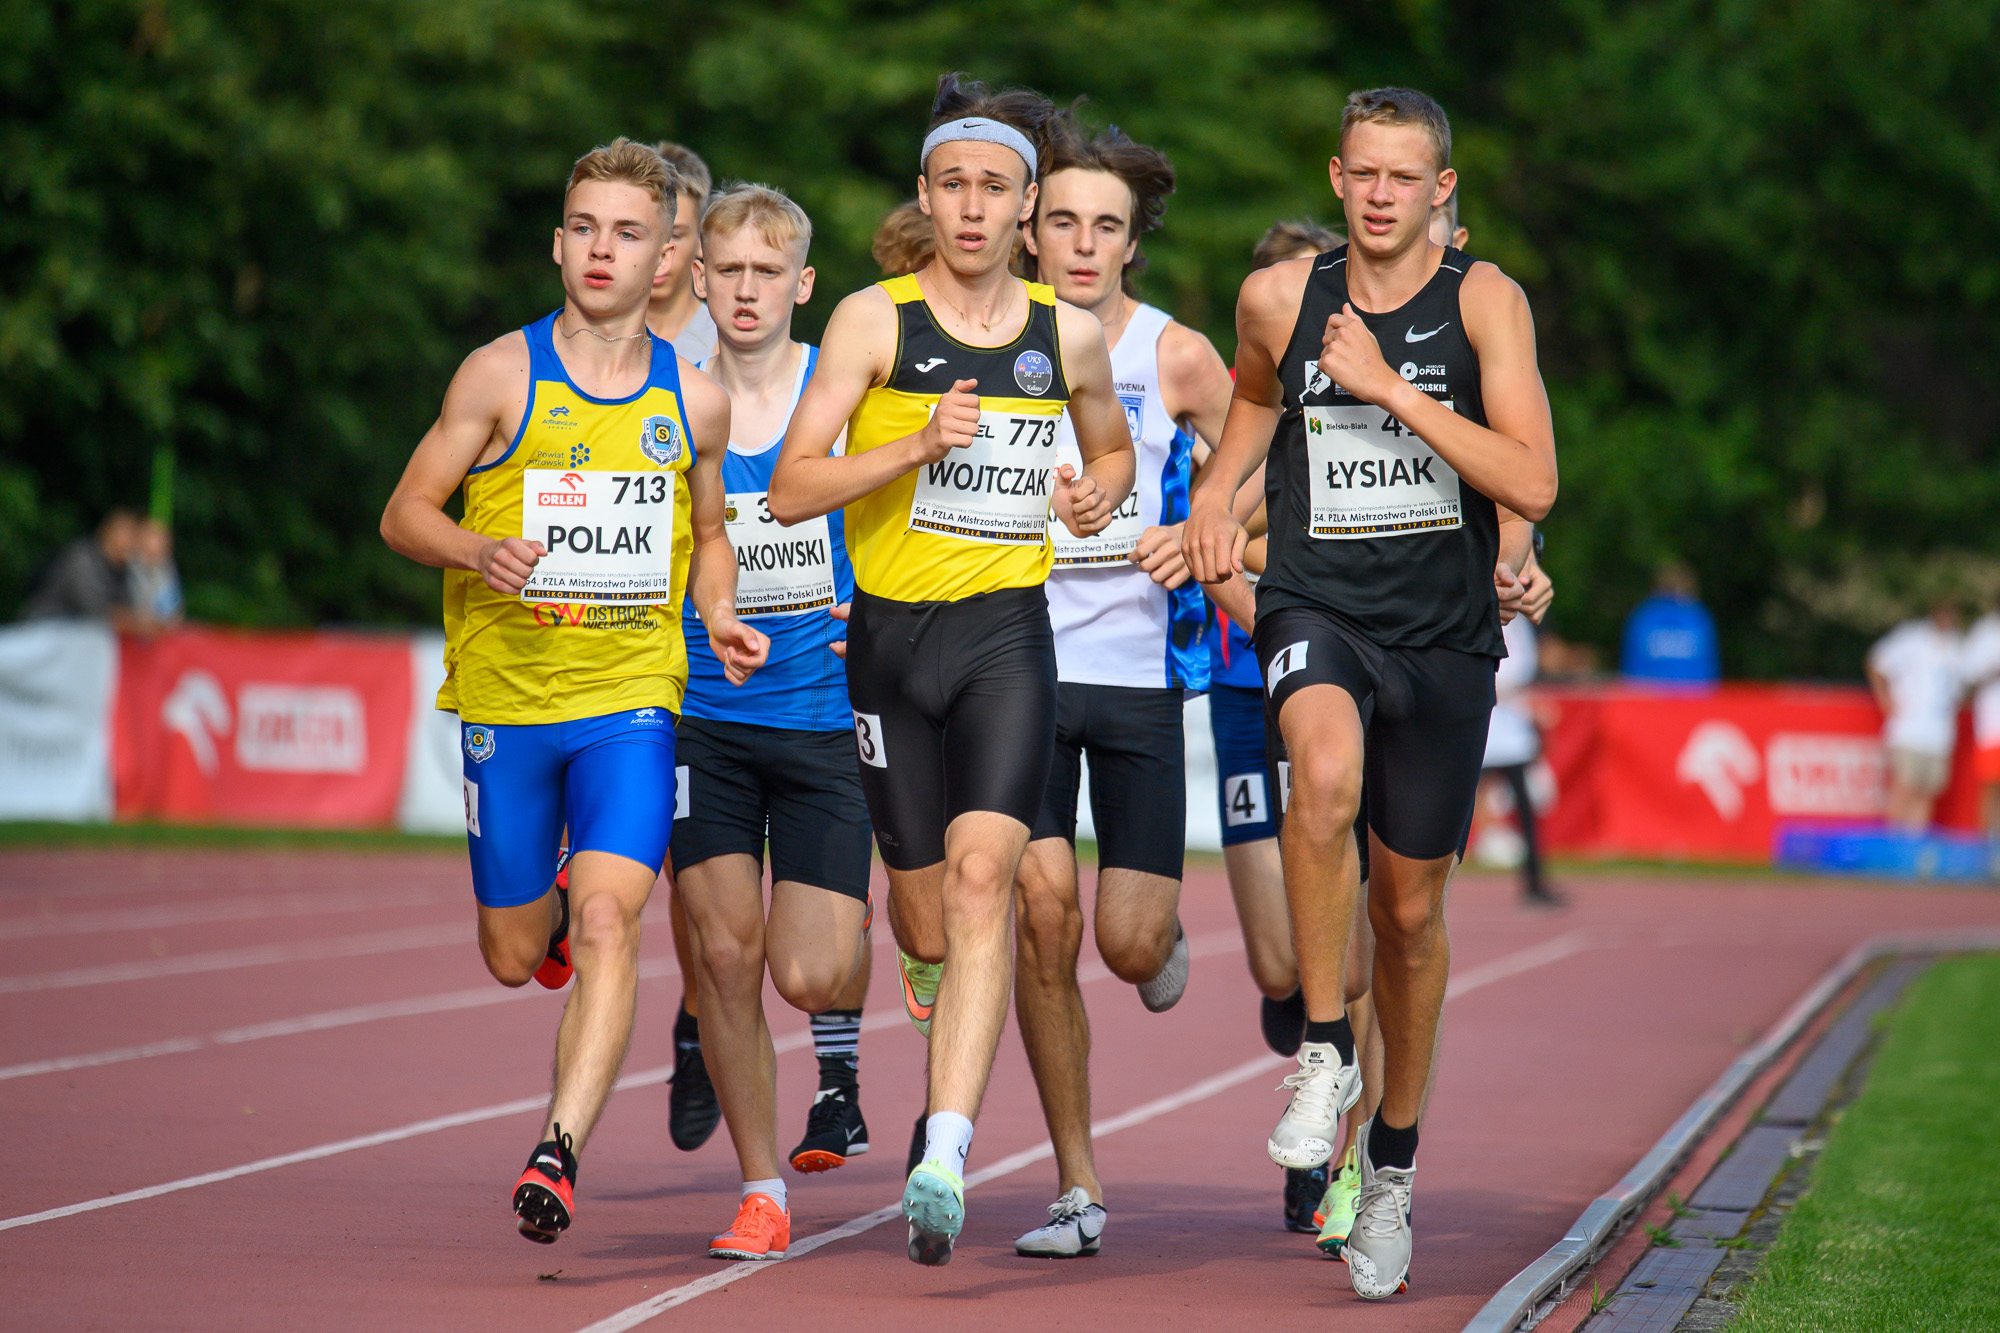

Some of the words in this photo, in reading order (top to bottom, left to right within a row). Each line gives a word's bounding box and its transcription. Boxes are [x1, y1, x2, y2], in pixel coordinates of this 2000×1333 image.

[1419, 368, 1446, 376] OPOLE
[1114, 382, 1146, 392] UVENIA
[1412, 383, 1447, 392] POLSKIE
[659, 429, 667, 440] S
[1009, 419, 1055, 447] 773
[1327, 423, 1368, 431] Bielsko-Biała
[537, 451, 564, 459] Powiat
[525, 459, 565, 467] ostrowski
[928, 460, 1050, 496] WOJTCZAK
[1327, 456, 1436, 489] ŁYSIAK
[612, 476, 666, 504] 713
[540, 494, 584, 505] ORLEN
[914, 506, 929, 517] 54.
[932, 510, 954, 521] PZLA
[957, 515, 1010, 528] Mistrzostwa
[1012, 519, 1033, 529] Polski
[1033, 520, 1045, 529] U18
[1314, 513, 1326, 522] 54.
[1328, 513, 1347, 522] PZLA
[1350, 511, 1406, 522] Mistrzostwa
[1410, 507, 1438, 518] Polski
[1440, 504, 1458, 515] U18
[915, 519, 980, 537] BIELSKO-BIAŁA
[1315, 526, 1377, 534] BIELSKO-BIAŁA
[1393, 518, 1456, 531] 15-17.07.2022
[547, 525, 652, 554] POLAK
[1105, 542, 1128, 551] Polski
[732, 538, 826, 572] AKOWSKI
[543, 577, 565, 586] PZLA
[569, 578, 626, 588] Mistrzostwa
[629, 579, 651, 588] Polski
[654, 578, 667, 587] U18
[527, 590, 595, 600] BIELSKO-BIAŁA
[611, 592, 665, 600] 15-17.07.2022
[787, 589, 814, 600] Polski
[816, 585, 832, 596] U18
[772, 597, 832, 612] 15-17.07.2022
[857, 716, 876, 761] 3
[1232, 779, 1256, 819] 4
